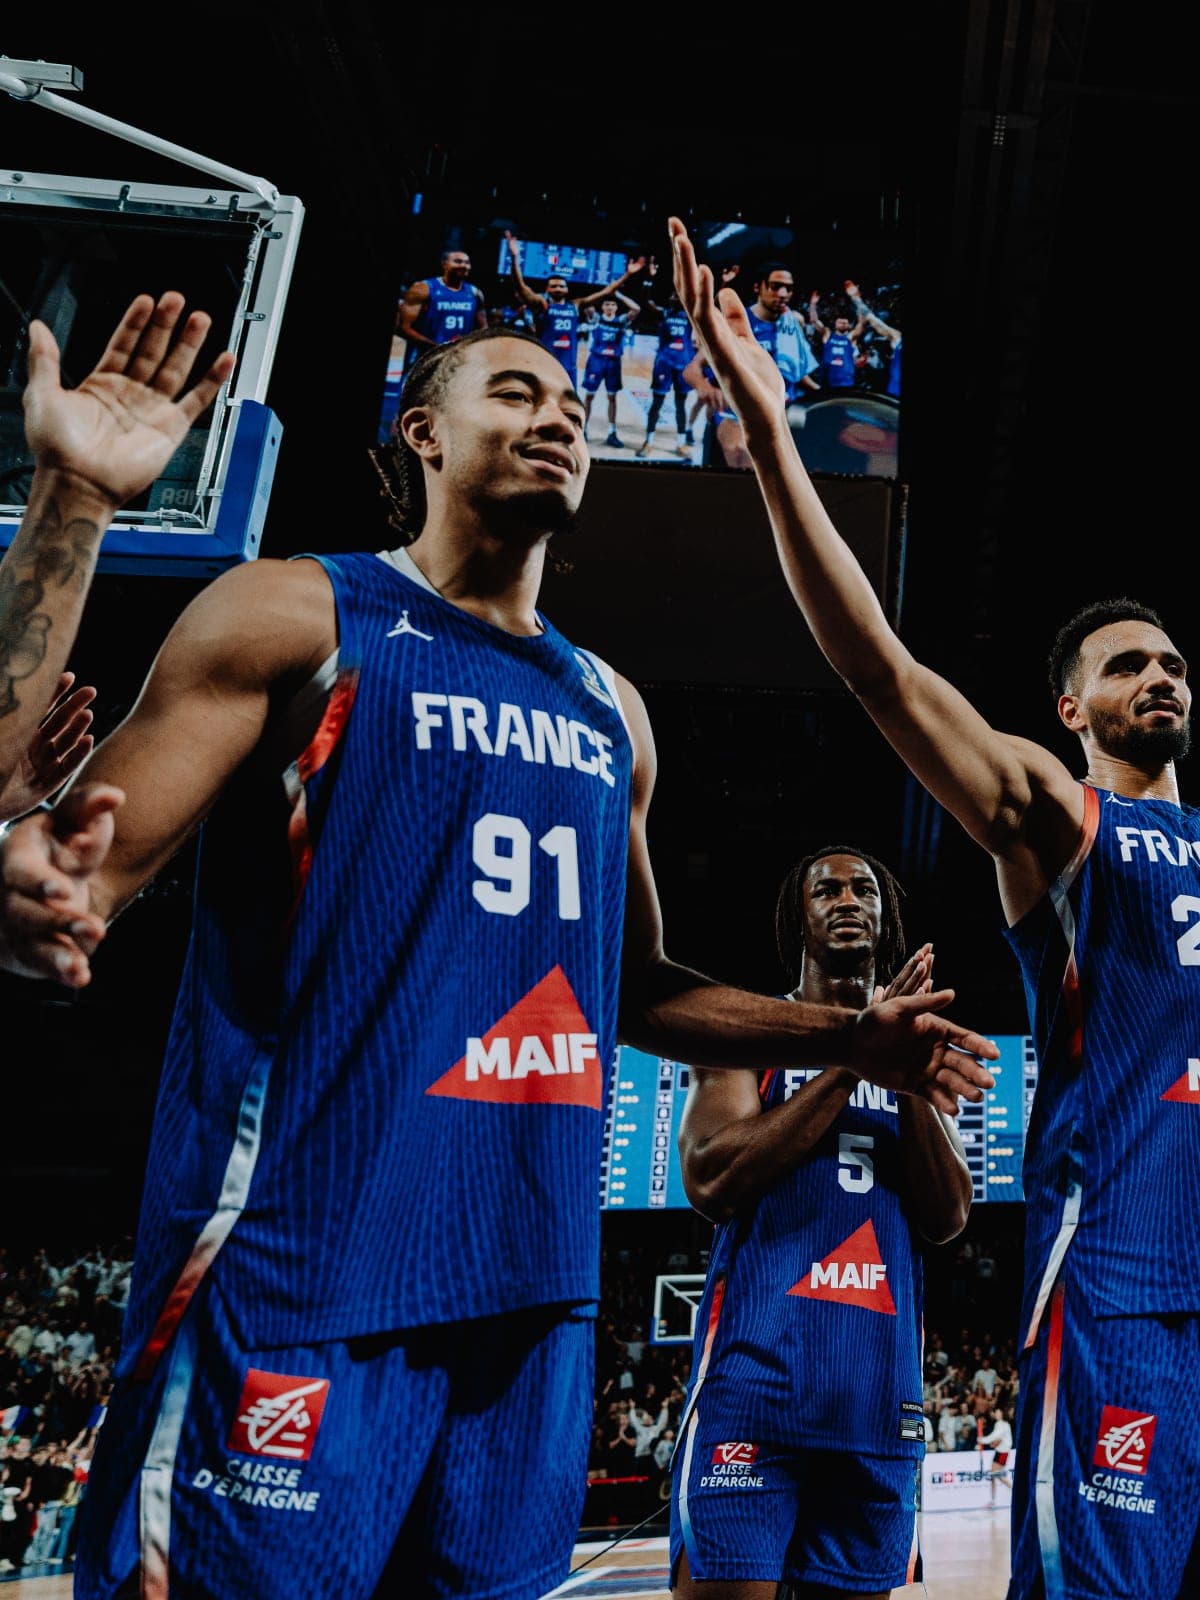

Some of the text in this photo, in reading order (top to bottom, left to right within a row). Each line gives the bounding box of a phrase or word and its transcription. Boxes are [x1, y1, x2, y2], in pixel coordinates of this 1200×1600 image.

[445, 316, 464, 329] 91
[555, 319, 571, 330] 20
[411, 692, 615, 787] FRANCE
[472, 813, 581, 920] 91
[465, 1033, 597, 1081] MAIF
[838, 1133, 874, 1193] 5
[810, 1262, 887, 1290] MAIF
[227, 1459, 302, 1488] CAISSE
[700, 1476, 764, 1487] D'EPARGNE
[712, 1464, 752, 1475] CAISSE
[192, 1469, 320, 1512] D'EPARGNE
[1092, 1473, 1144, 1495] CAISSE
